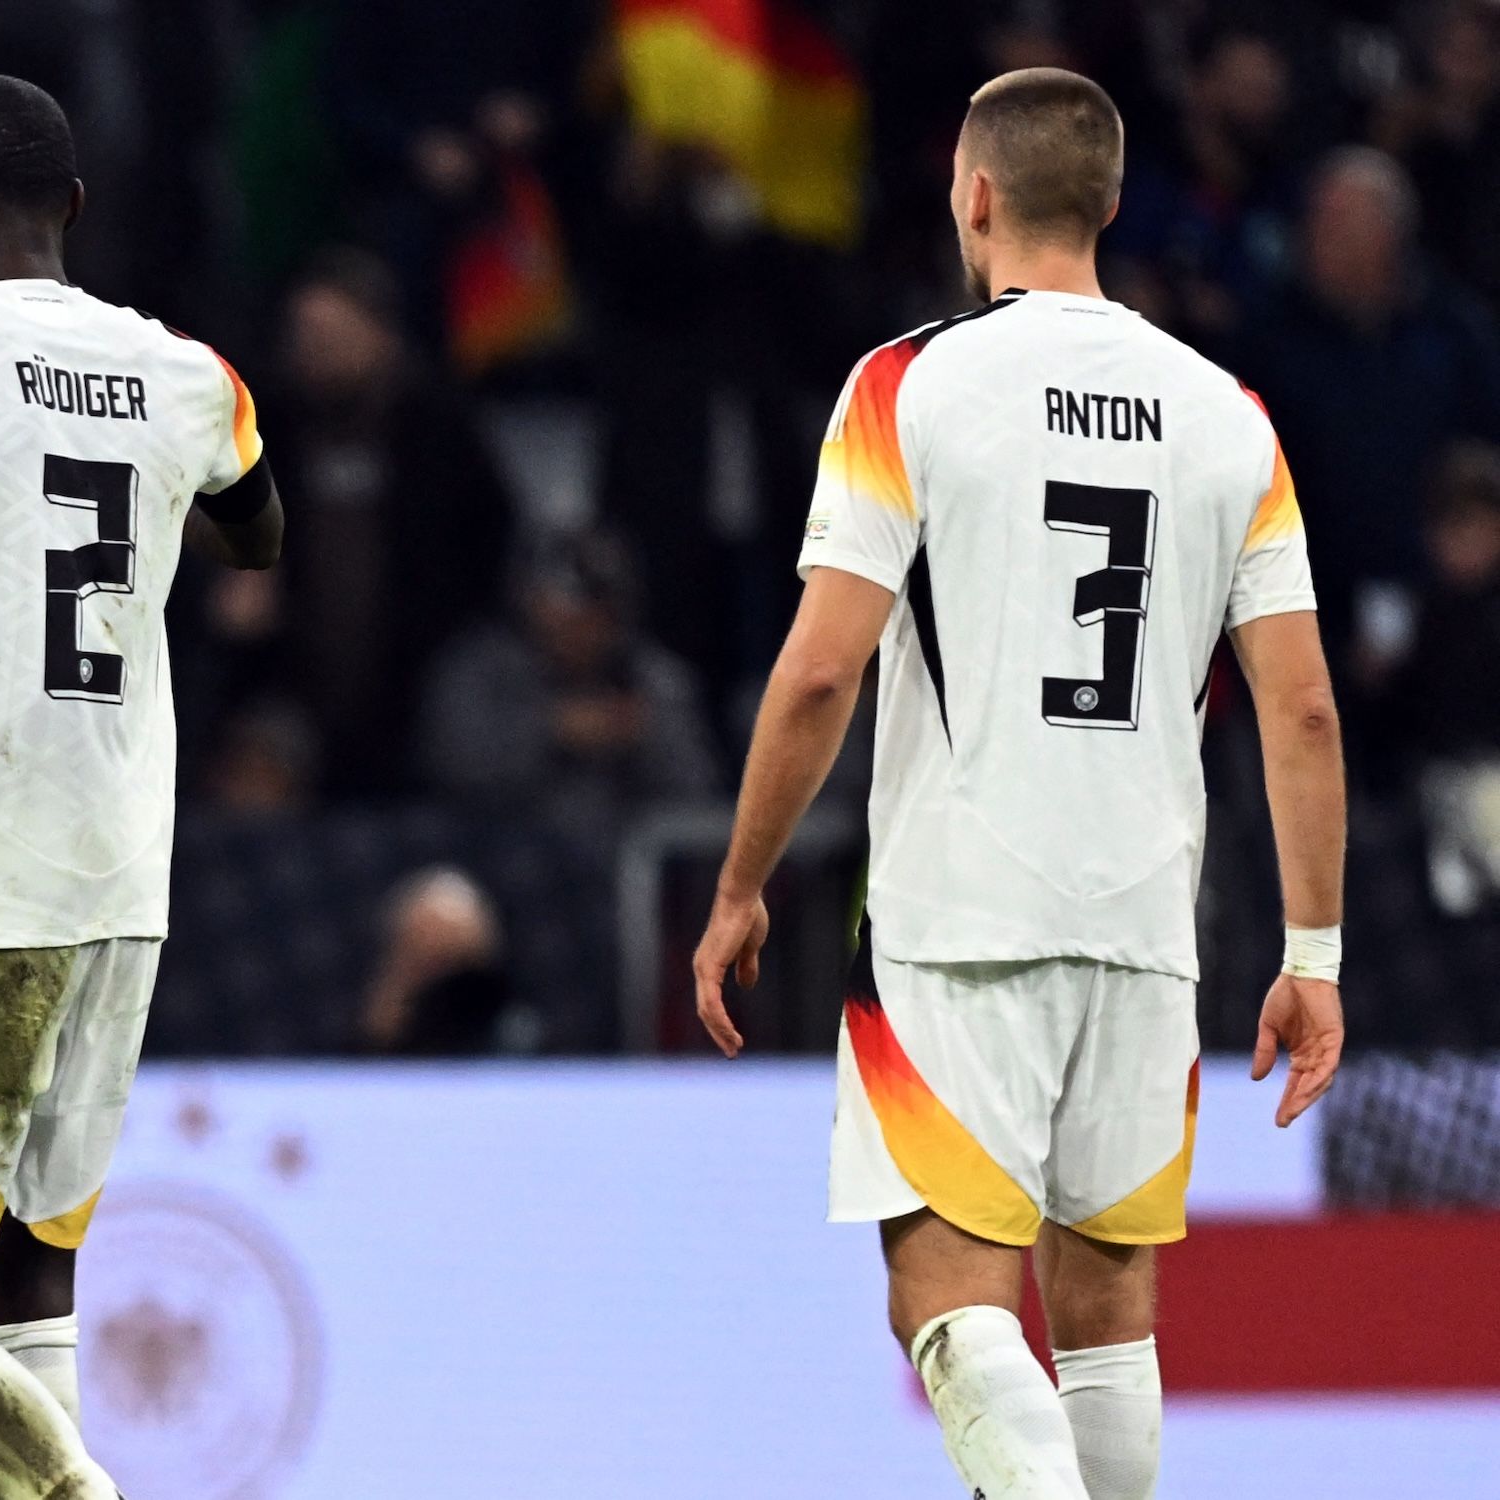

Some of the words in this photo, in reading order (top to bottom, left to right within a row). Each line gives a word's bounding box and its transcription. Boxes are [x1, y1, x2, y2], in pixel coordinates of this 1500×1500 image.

[15, 355, 148, 421] RÜDIGER
[1045, 387, 1162, 442] ANTON
[42, 454, 140, 705] 2
[1041, 480, 1159, 731] 3
